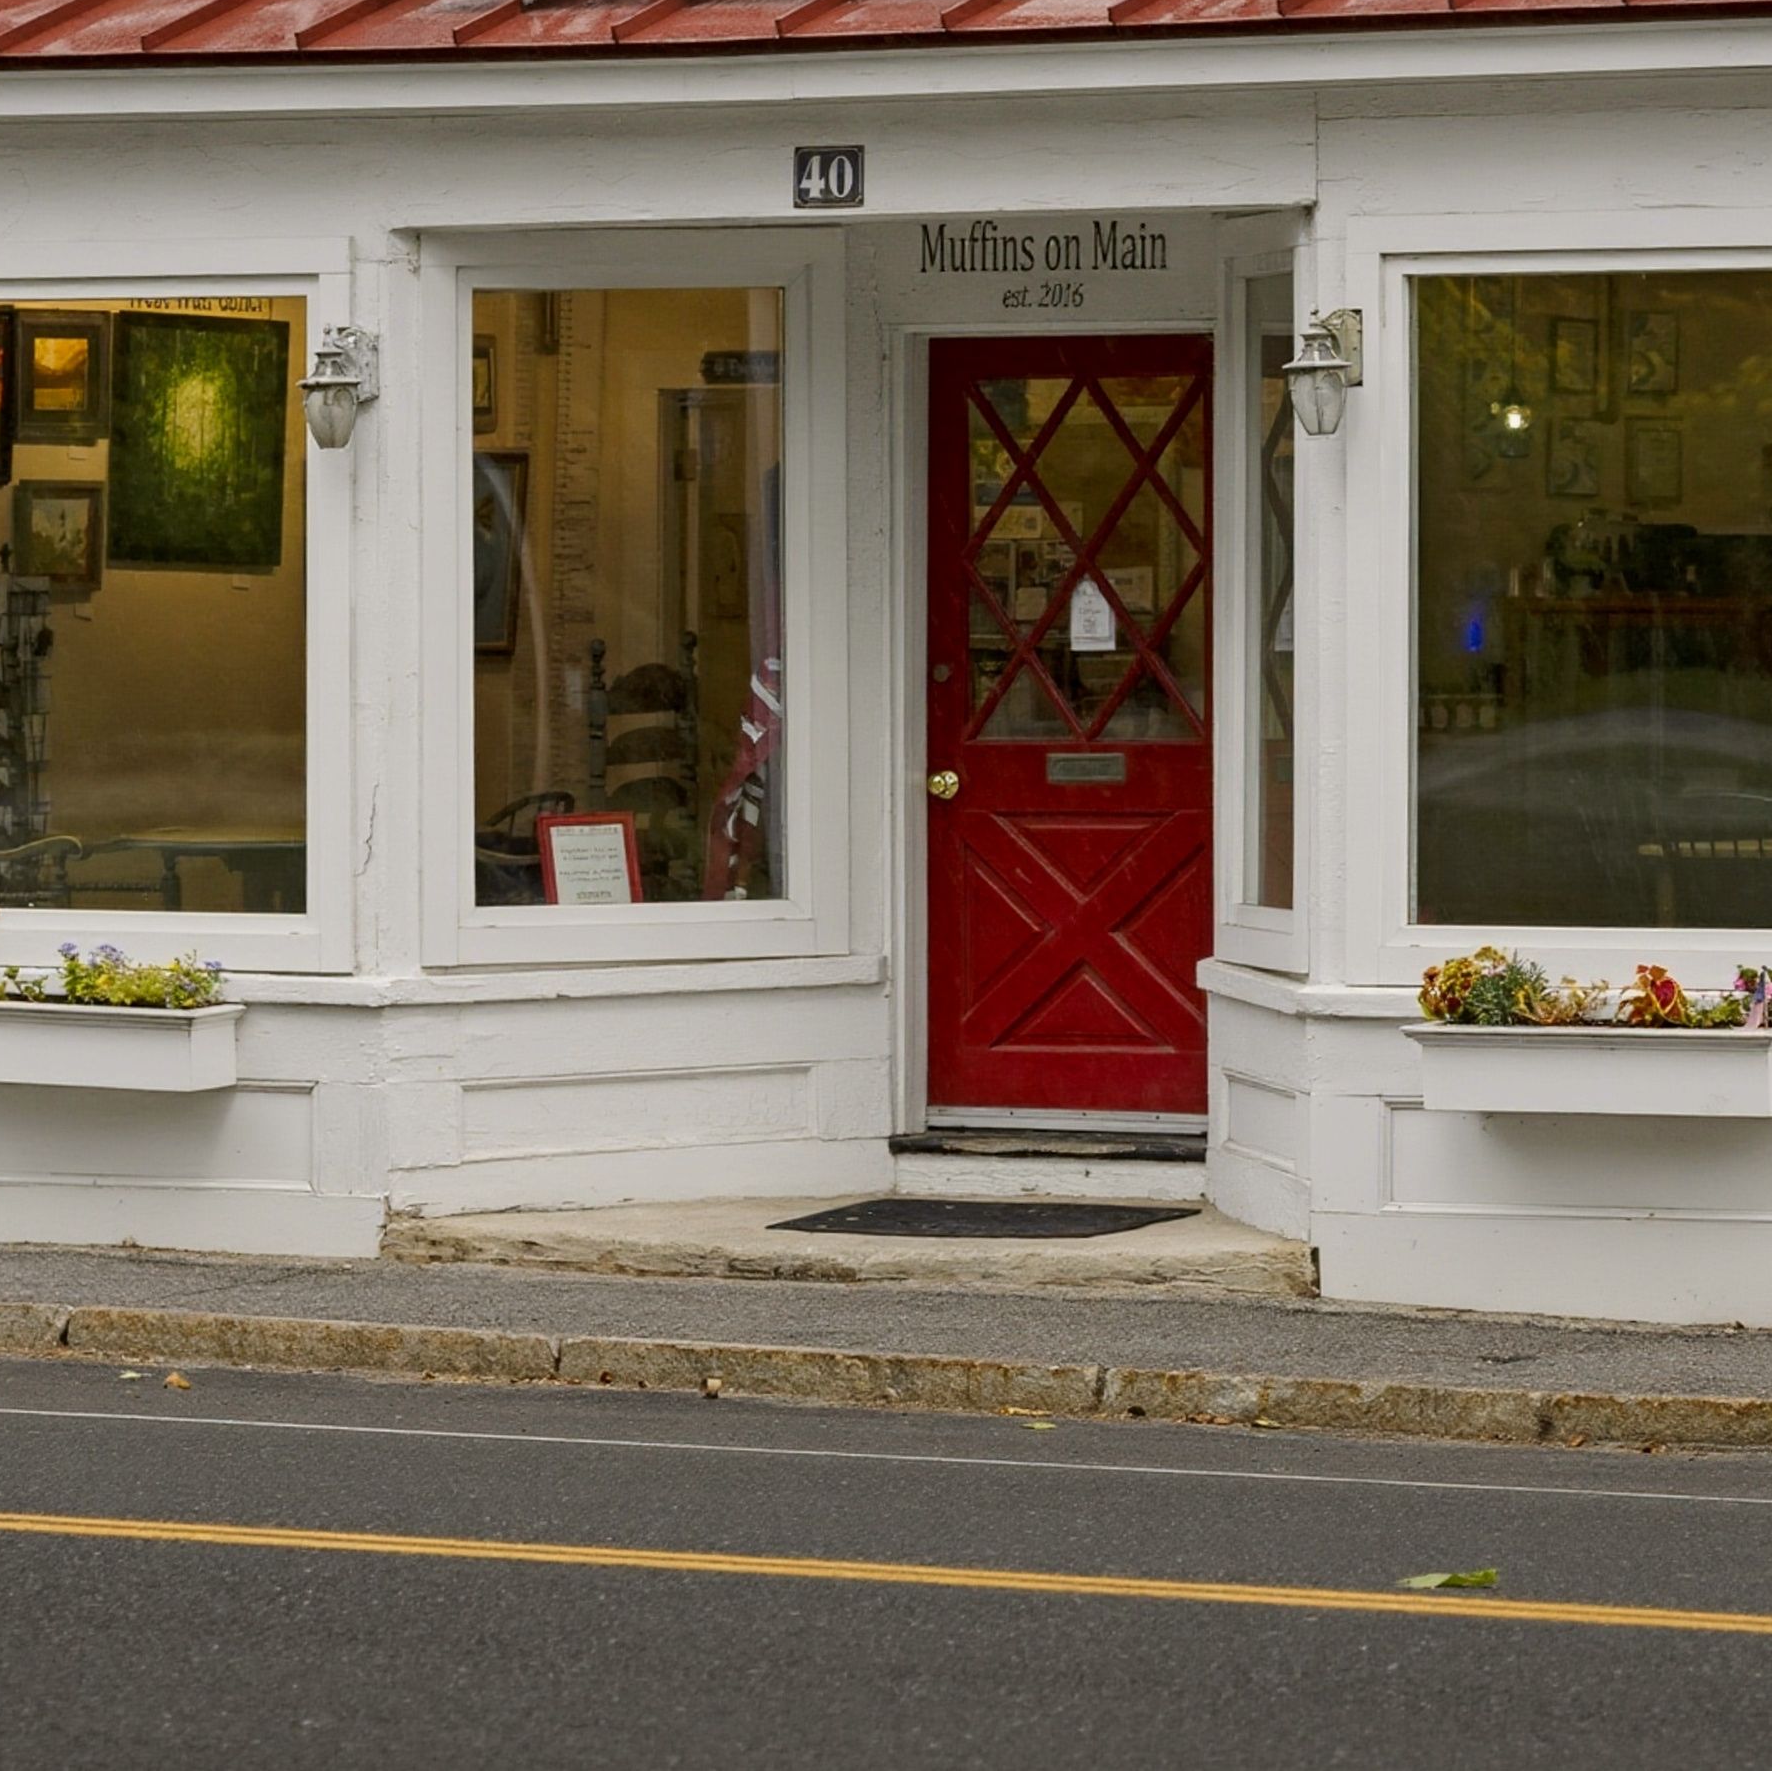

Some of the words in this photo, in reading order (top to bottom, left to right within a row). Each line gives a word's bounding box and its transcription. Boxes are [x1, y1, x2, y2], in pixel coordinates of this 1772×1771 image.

[798, 154, 854, 199] 40
[920, 220, 1035, 273] Muffins
[1045, 234, 1081, 271] on
[1092, 220, 1167, 270] Main
[1002, 286, 1033, 308] est.
[1037, 282, 1085, 308] 2016
